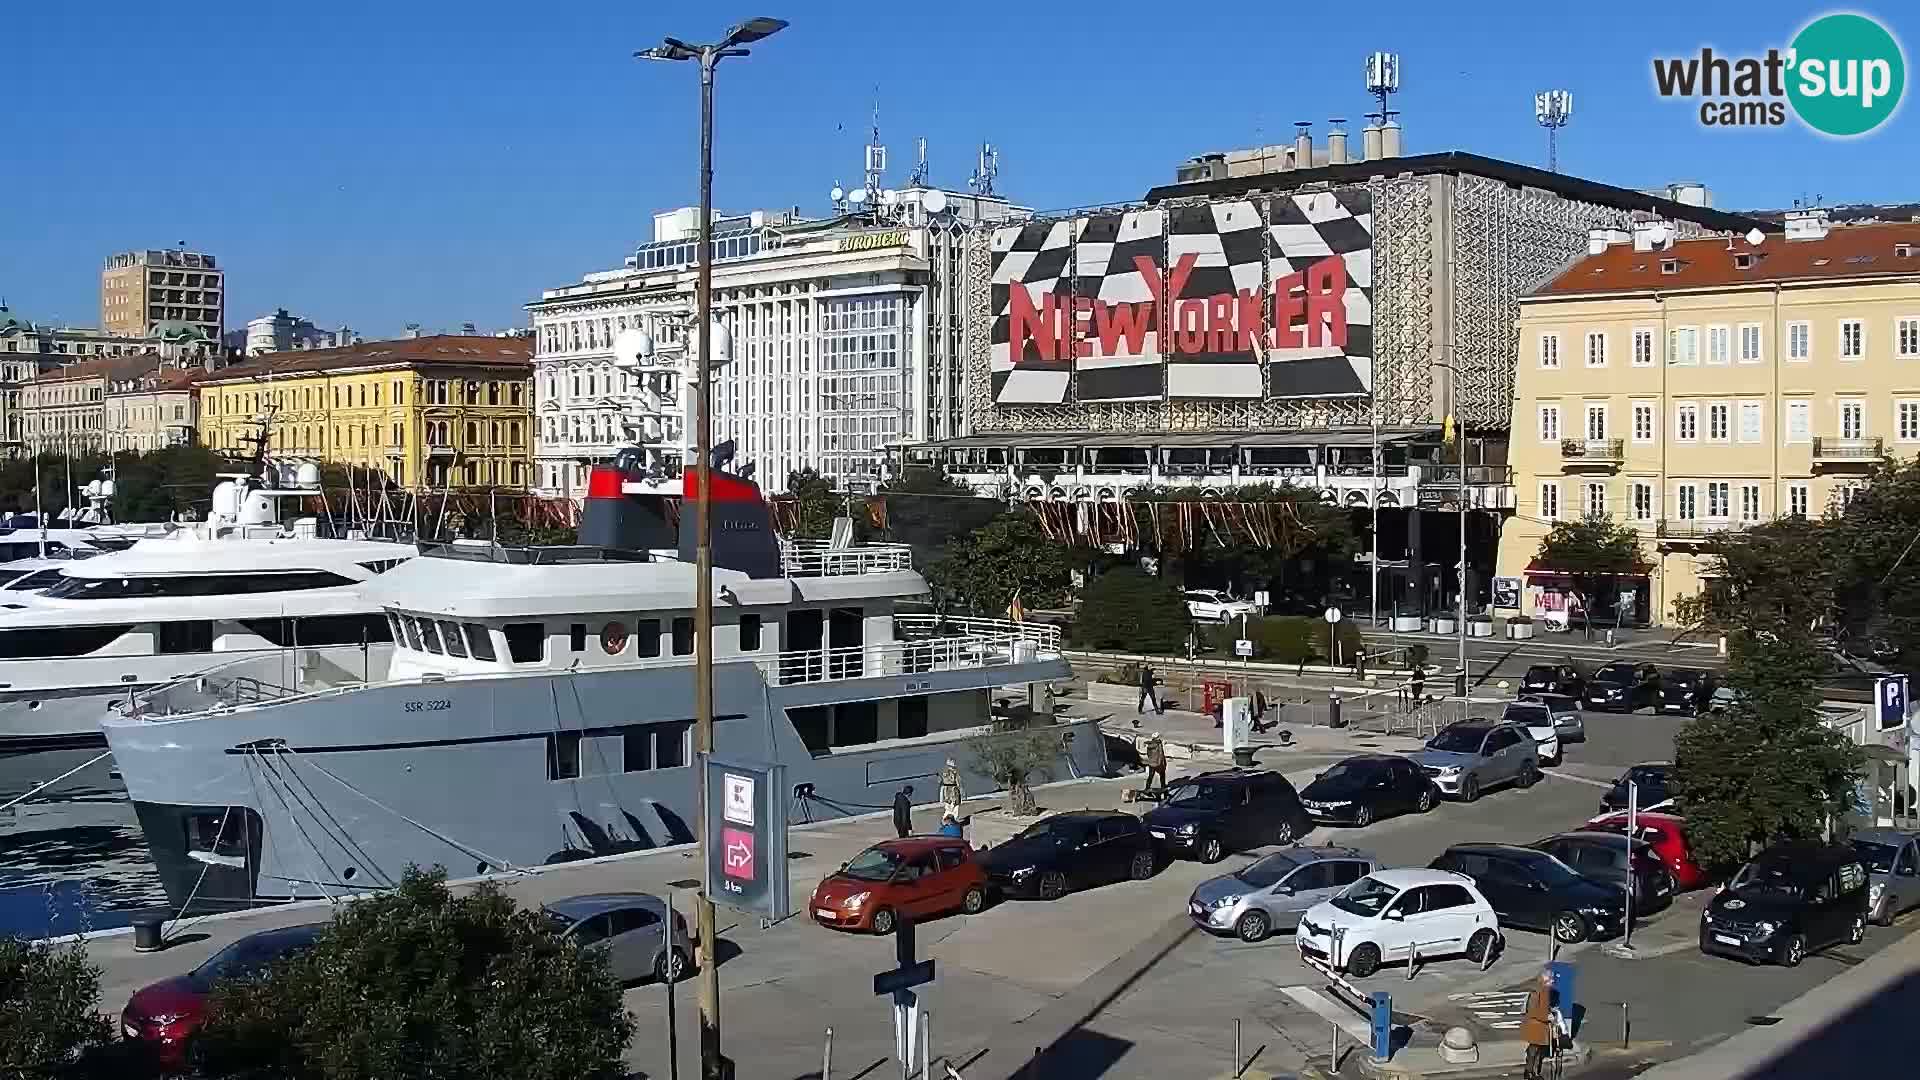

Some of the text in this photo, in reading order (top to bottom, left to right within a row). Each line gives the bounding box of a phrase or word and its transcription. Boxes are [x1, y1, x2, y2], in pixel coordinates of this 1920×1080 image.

[1886, 682, 1899, 707] P
[404, 700, 451, 712] SSR 5224
